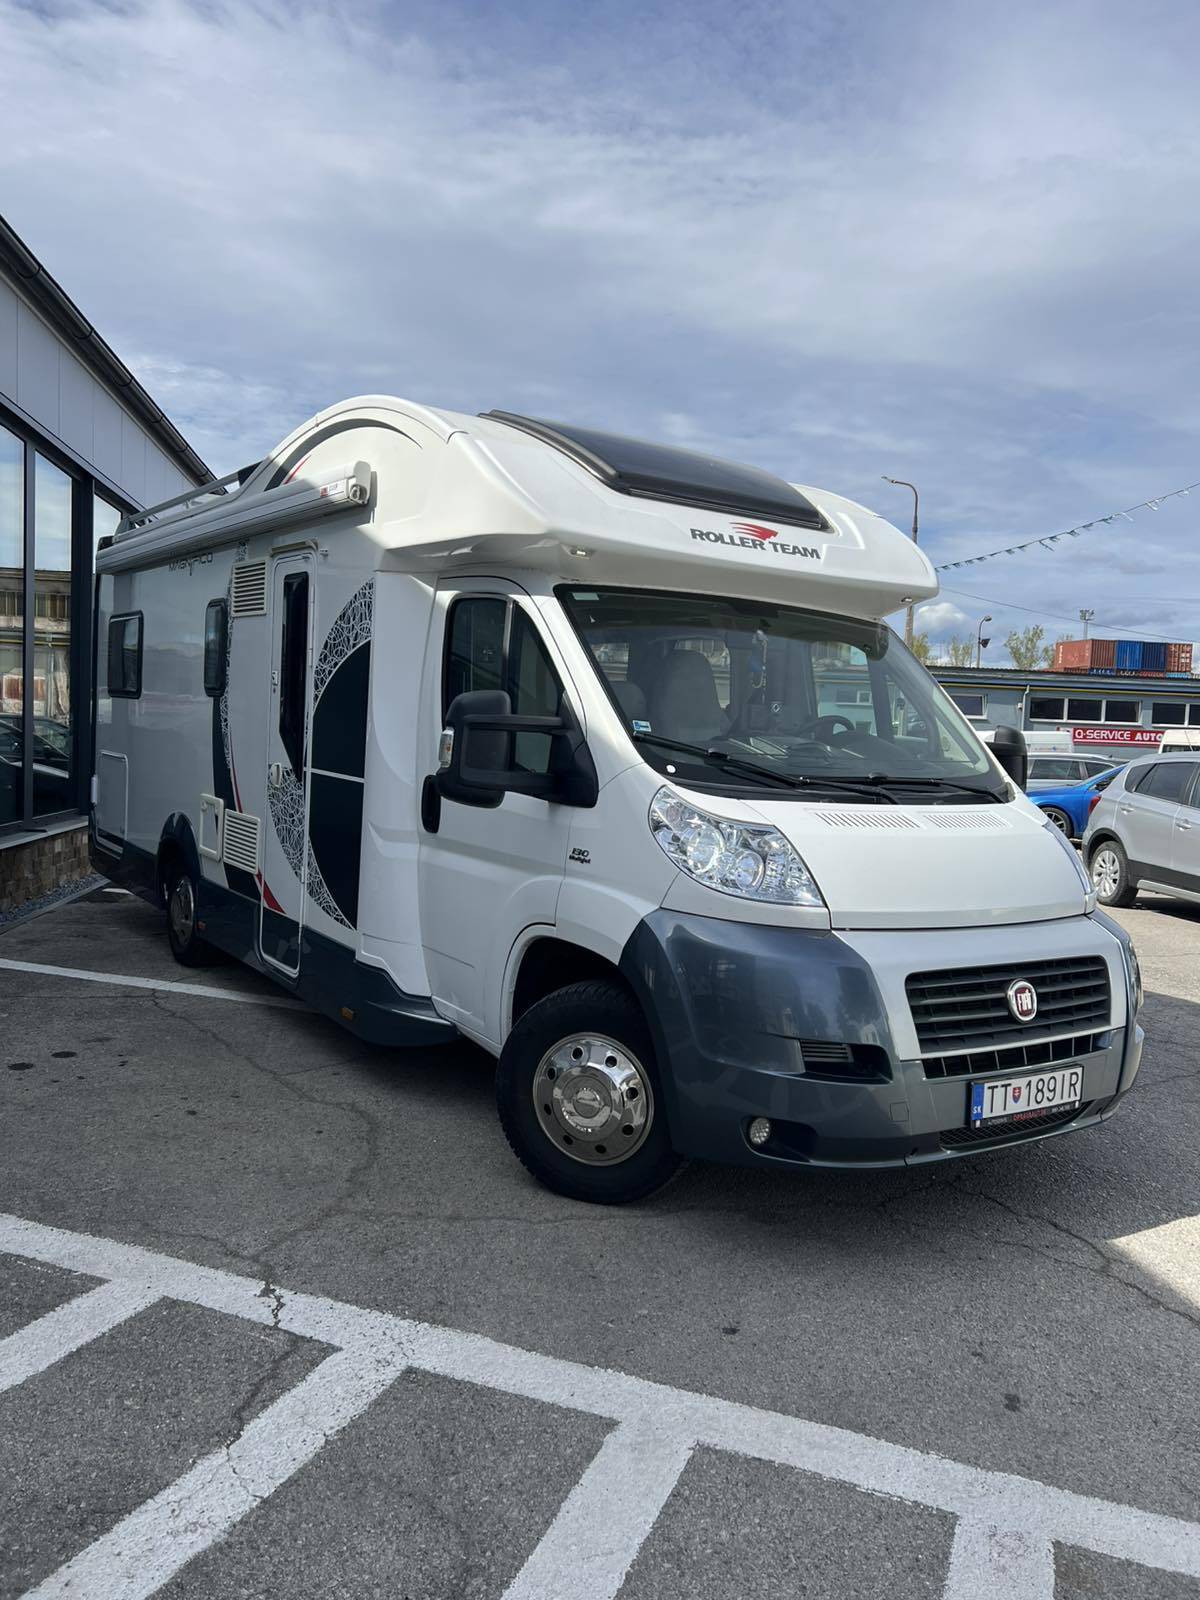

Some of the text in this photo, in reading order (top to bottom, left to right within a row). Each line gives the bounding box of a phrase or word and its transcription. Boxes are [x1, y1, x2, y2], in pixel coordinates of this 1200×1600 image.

[690, 528, 821, 559] ROLLER TEAM
[1135, 732, 1163, 742] AUTO
[1017, 988, 1033, 1012] FIAT
[973, 1105, 982, 1115] SK
[987, 1083, 1012, 1114] TT
